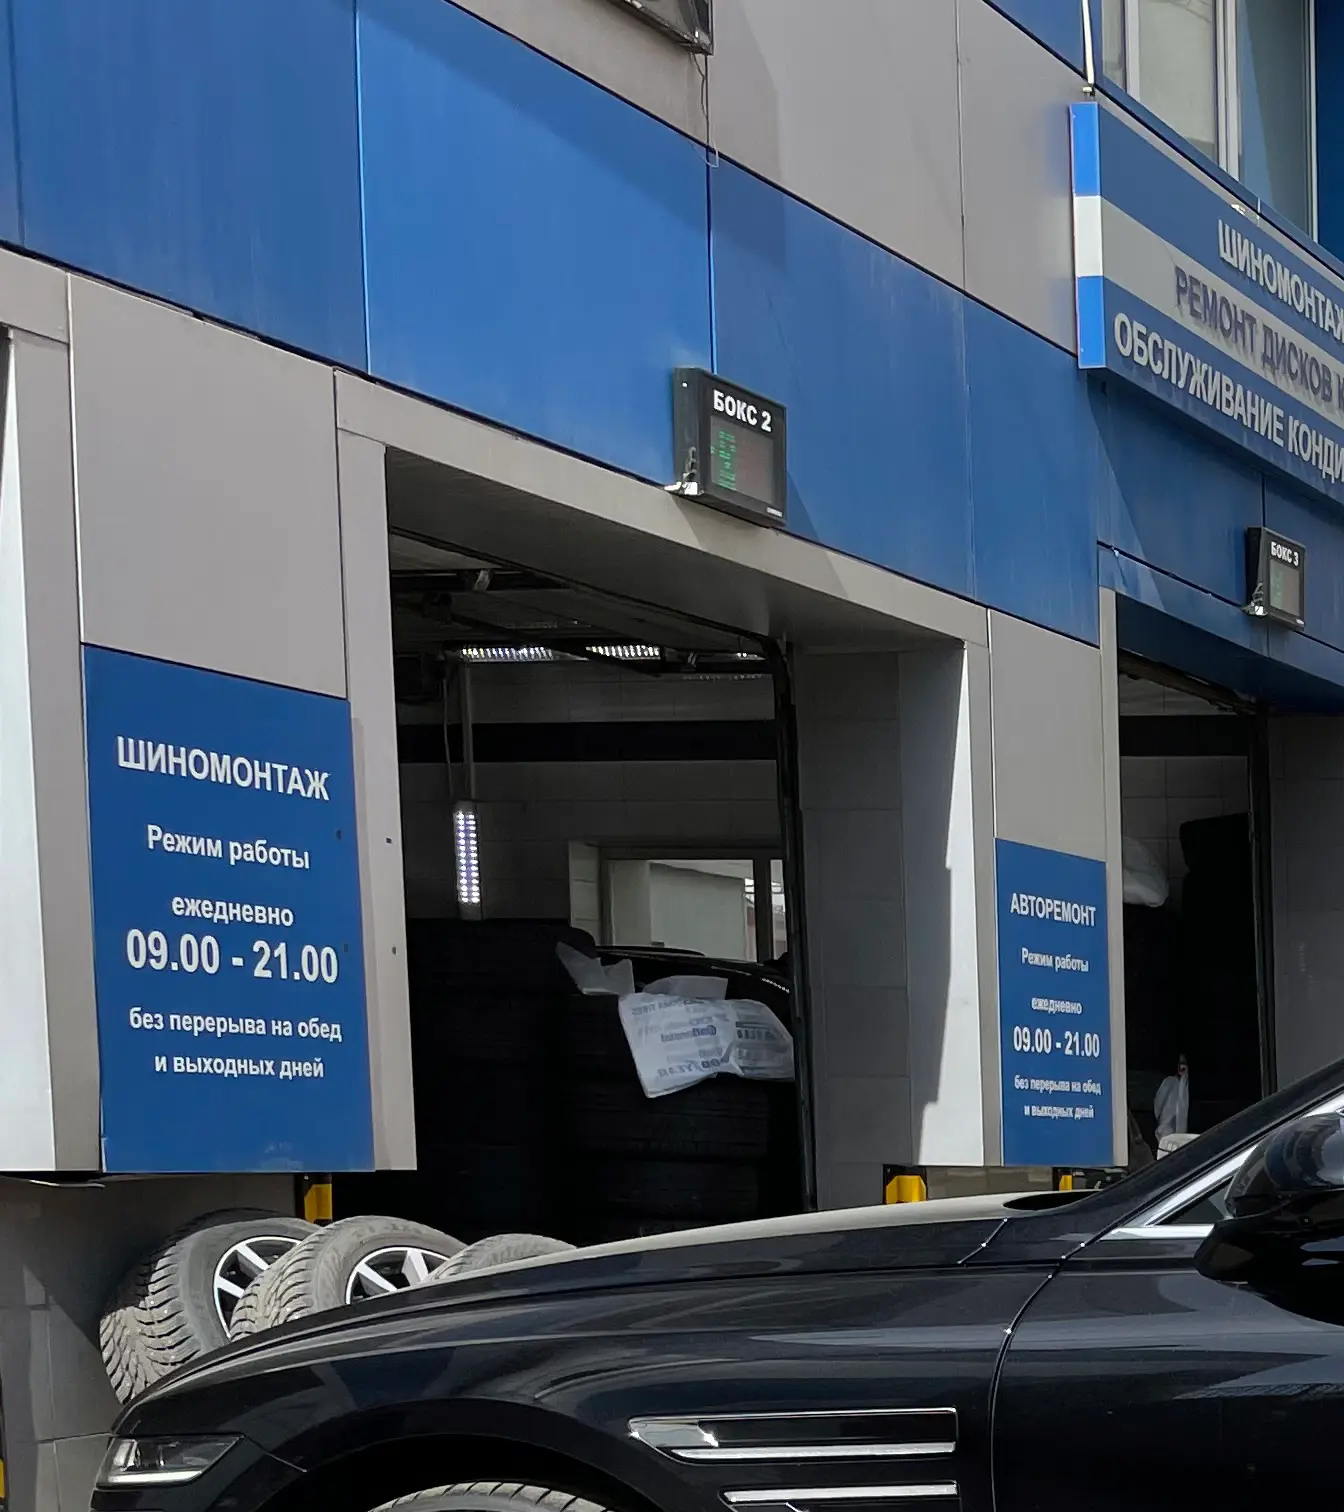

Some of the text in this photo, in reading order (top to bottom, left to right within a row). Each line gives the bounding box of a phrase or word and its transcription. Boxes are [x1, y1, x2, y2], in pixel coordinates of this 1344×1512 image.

[1174, 265, 1256, 352] РЕМОНТ
[1261, 324, 1332, 402] ДИСКОВ
[1114, 313, 1285, 447] ОБСЛУЖИВАНИЕ
[713, 389, 772, 432] БОКС 2
[1271, 541, 1299, 567] БОКС 3
[117, 735, 331, 801] ШИНОМОНТАЖ
[147, 824, 310, 869] Режим работы
[172, 897, 294, 926] ежедневно
[1010, 893, 1096, 927] АВТОРЕМОНТ
[126, 929, 339, 983] 09.00 - 21.00
[1022, 948, 1088, 972] Режим работы
[1032, 997, 1082, 1014] ежедневно
[130, 1007, 343, 1042] без перерыва на обед
[1013, 1026, 1051, 1054] 09.00
[1064, 1030, 1100, 1057] 21.00
[154, 1056, 324, 1080] и выходных дней
[1014, 1075, 1101, 1096] без перерыва на обед
[1024, 1105, 1094, 1120] и выходных дней
